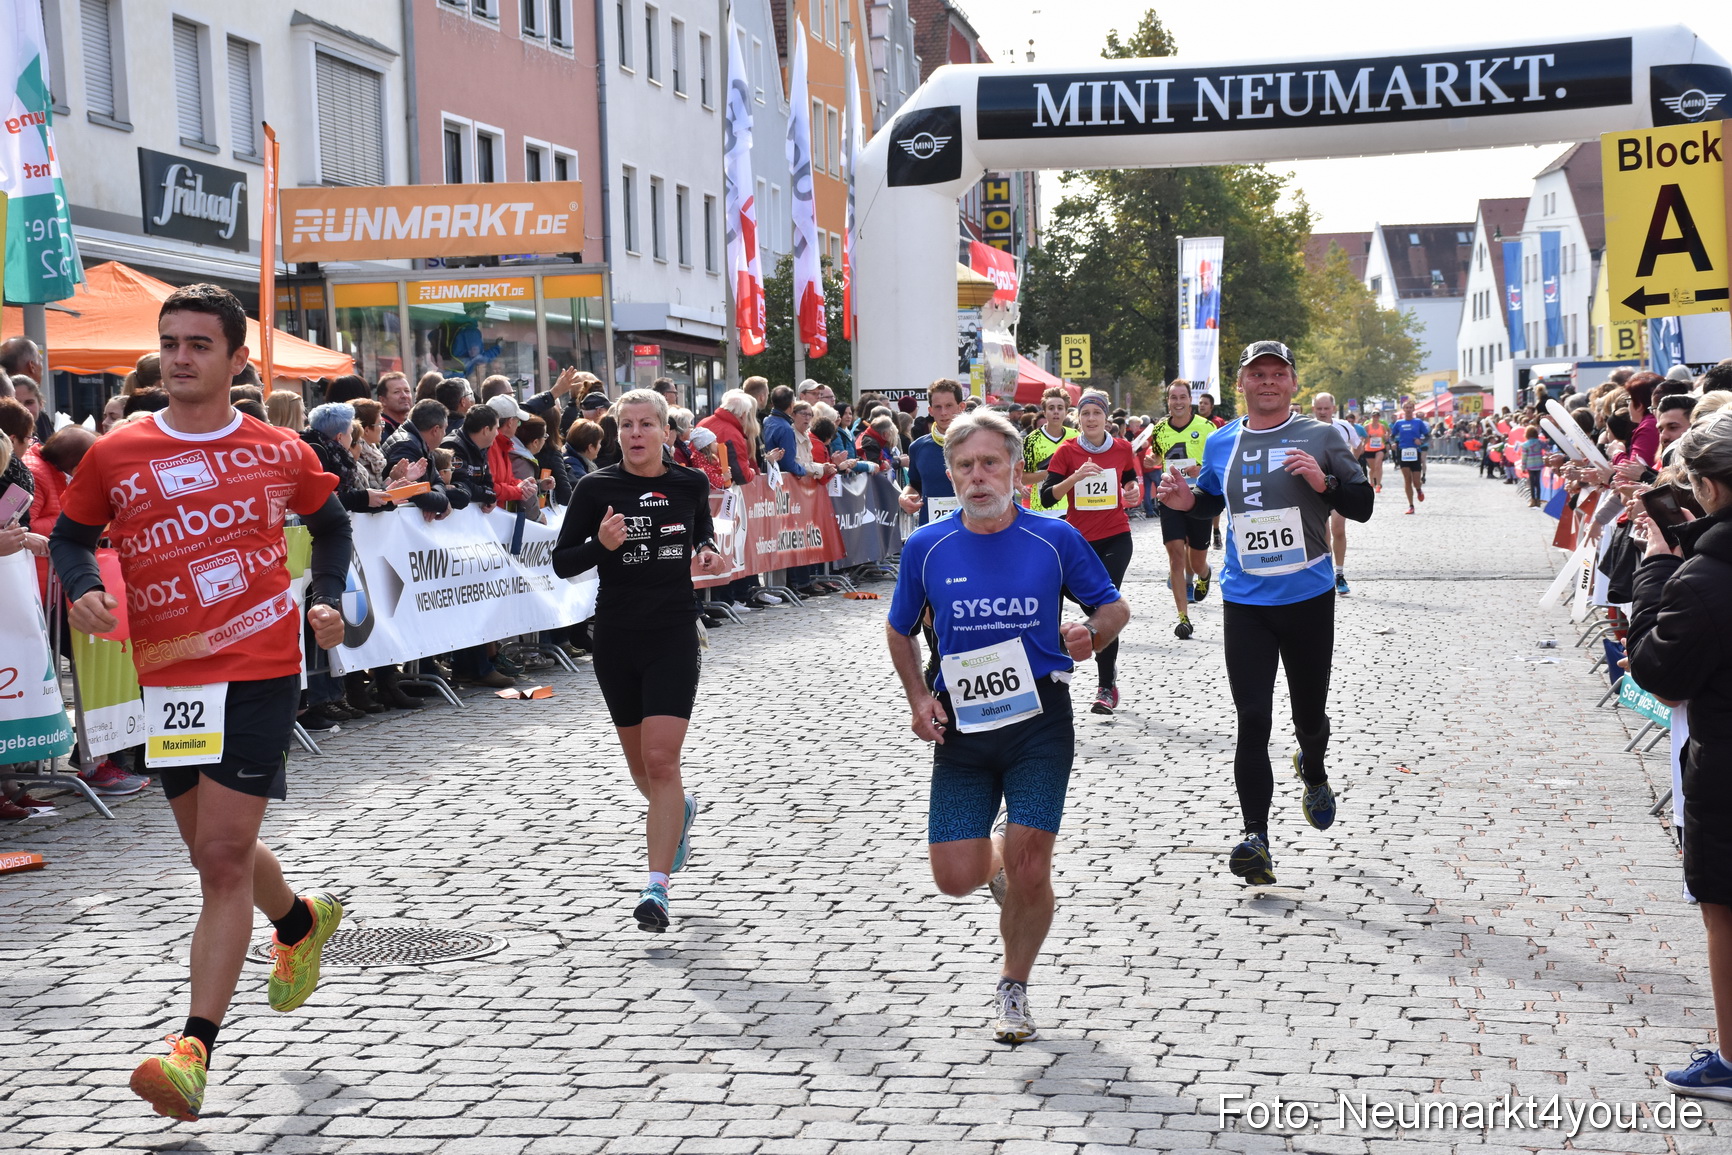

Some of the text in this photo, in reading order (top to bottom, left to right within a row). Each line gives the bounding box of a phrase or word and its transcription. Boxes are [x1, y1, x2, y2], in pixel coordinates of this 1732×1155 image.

[1032, 54, 1568, 127] MINI NEUMARKT.
[914, 141, 934, 150] MINI
[1617, 130, 1723, 171] Block
[153, 163, 247, 240] frühauf
[1635, 183, 1714, 278] A
[419, 282, 525, 300] RUNMARKT.DE
[1064, 336, 1087, 345] Block
[1618, 328, 1636, 351] B
[1069, 347, 1083, 369] B
[1189, 380, 1206, 390] wn
[154, 452, 202, 471] raumbox
[1085, 481, 1108, 495] 124
[639, 499, 670, 508] skinfit
[1245, 527, 1294, 551] 2516
[159, 541, 206, 561] wohnen
[1260, 554, 1283, 564] Rudolf
[192, 554, 237, 574] raumbox
[408, 548, 449, 583] BMW
[1582, 568, 1590, 590] swn
[414, 587, 456, 612] WENIGER
[951, 597, 1039, 619] SYSCAD
[207, 605, 273, 646] raumbox
[135, 630, 206, 668] Team
[957, 666, 1021, 701] 2466
[163, 700, 206, 730] 232
[980, 702, 1012, 717] Johann
[162, 738, 207, 751] Maximilian
